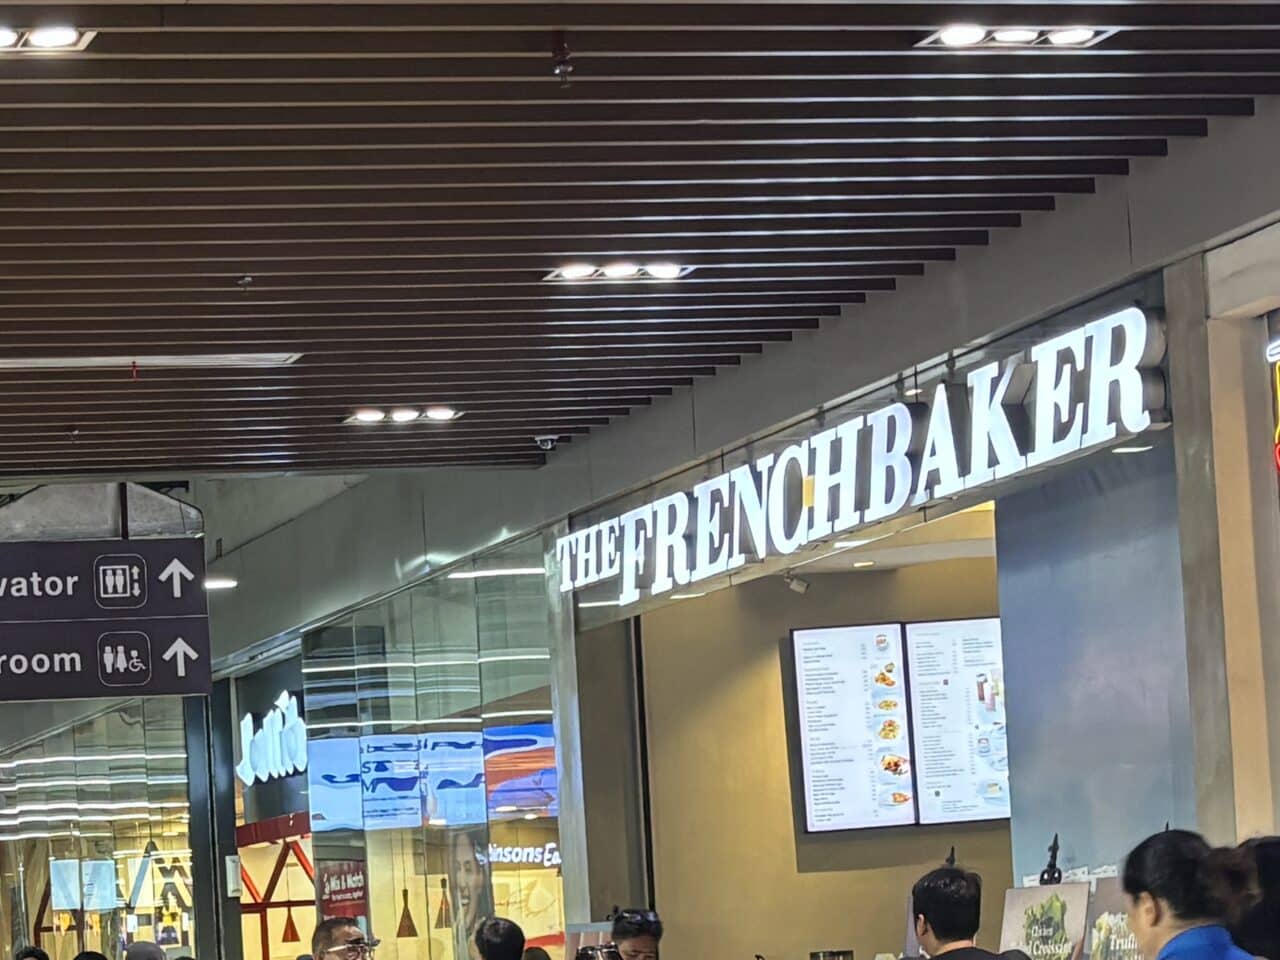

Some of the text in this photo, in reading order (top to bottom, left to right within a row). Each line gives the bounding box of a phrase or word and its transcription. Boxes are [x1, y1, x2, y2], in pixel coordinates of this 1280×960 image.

[556, 307, 1151, 606] THE FRENCH BAKER
